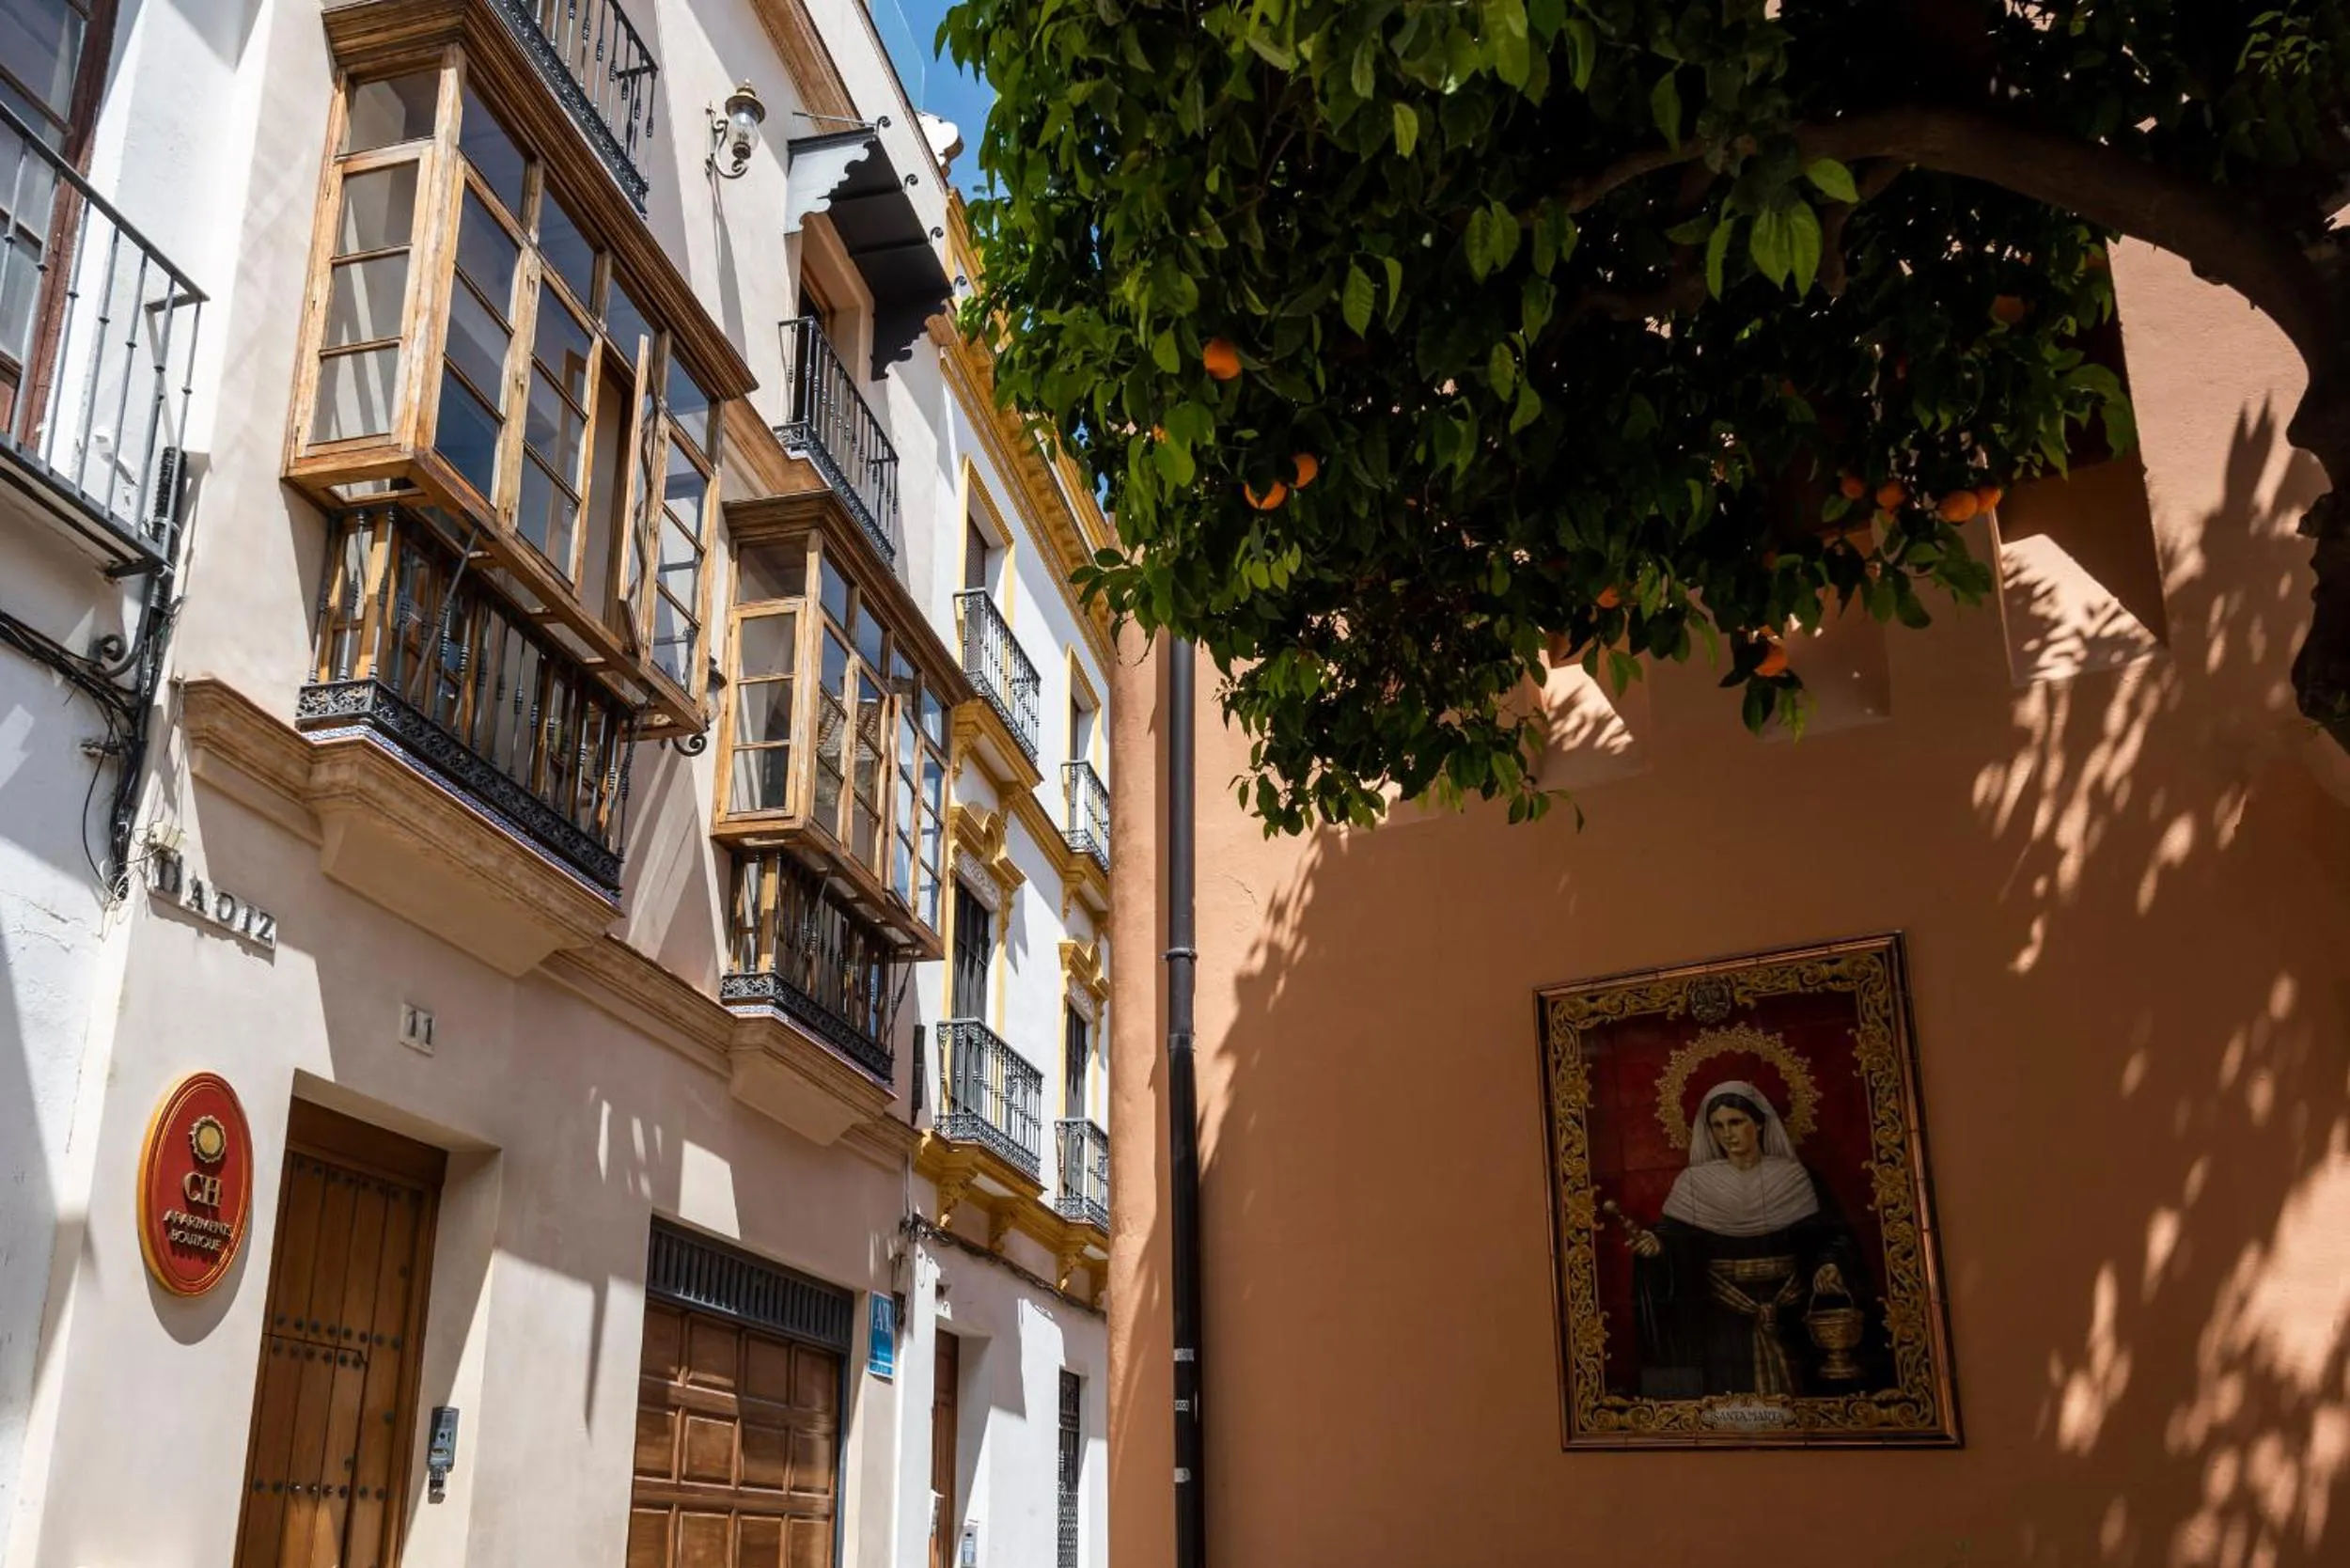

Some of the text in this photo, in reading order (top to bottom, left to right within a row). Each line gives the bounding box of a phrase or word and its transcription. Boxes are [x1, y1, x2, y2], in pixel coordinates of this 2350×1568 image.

[409, 1010, 433, 1045] 11
[183, 1172, 222, 1207] CH
[163, 1209, 232, 1237] APARTMENTS
[170, 1229, 222, 1250] BOUTIQUE
